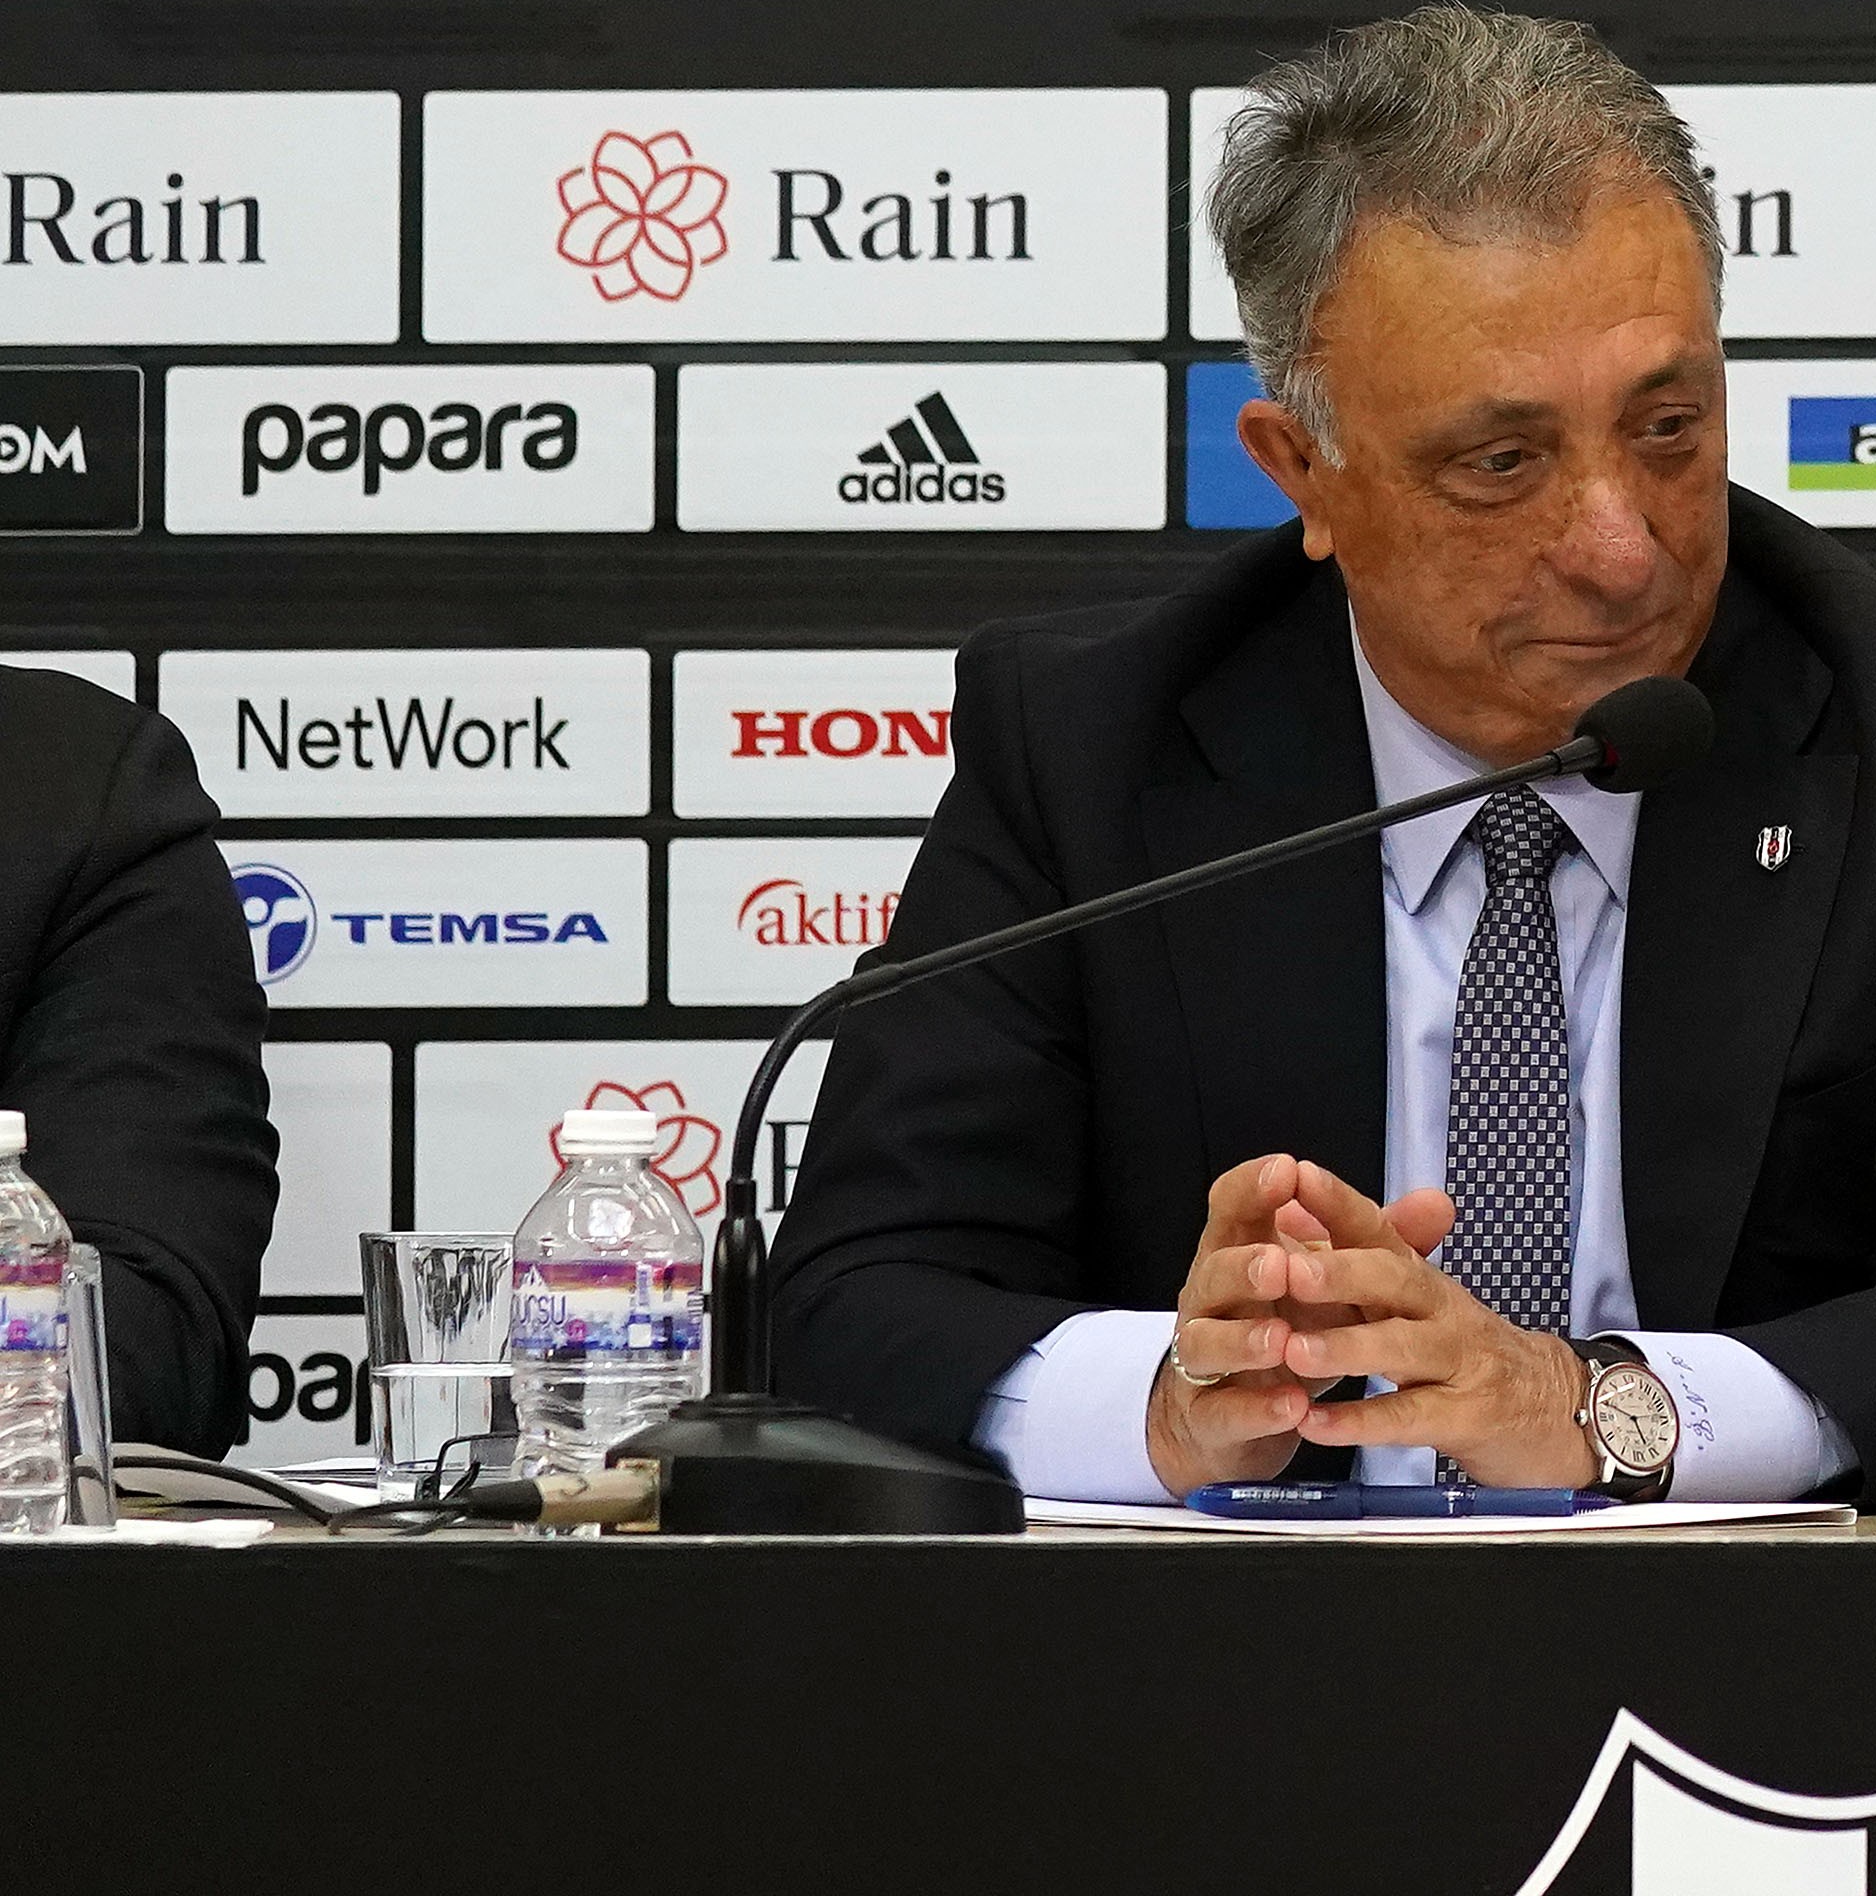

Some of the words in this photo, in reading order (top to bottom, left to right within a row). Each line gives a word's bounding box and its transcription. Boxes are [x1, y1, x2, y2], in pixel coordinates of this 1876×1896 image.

[3, 172, 265, 265] Rain
[772, 169, 1032, 262] Rain
[242, 401, 578, 497] papara
[838, 465, 1006, 504] adidas
[237, 696, 570, 771] NetWork
[331, 913, 609, 945] TEMSA
